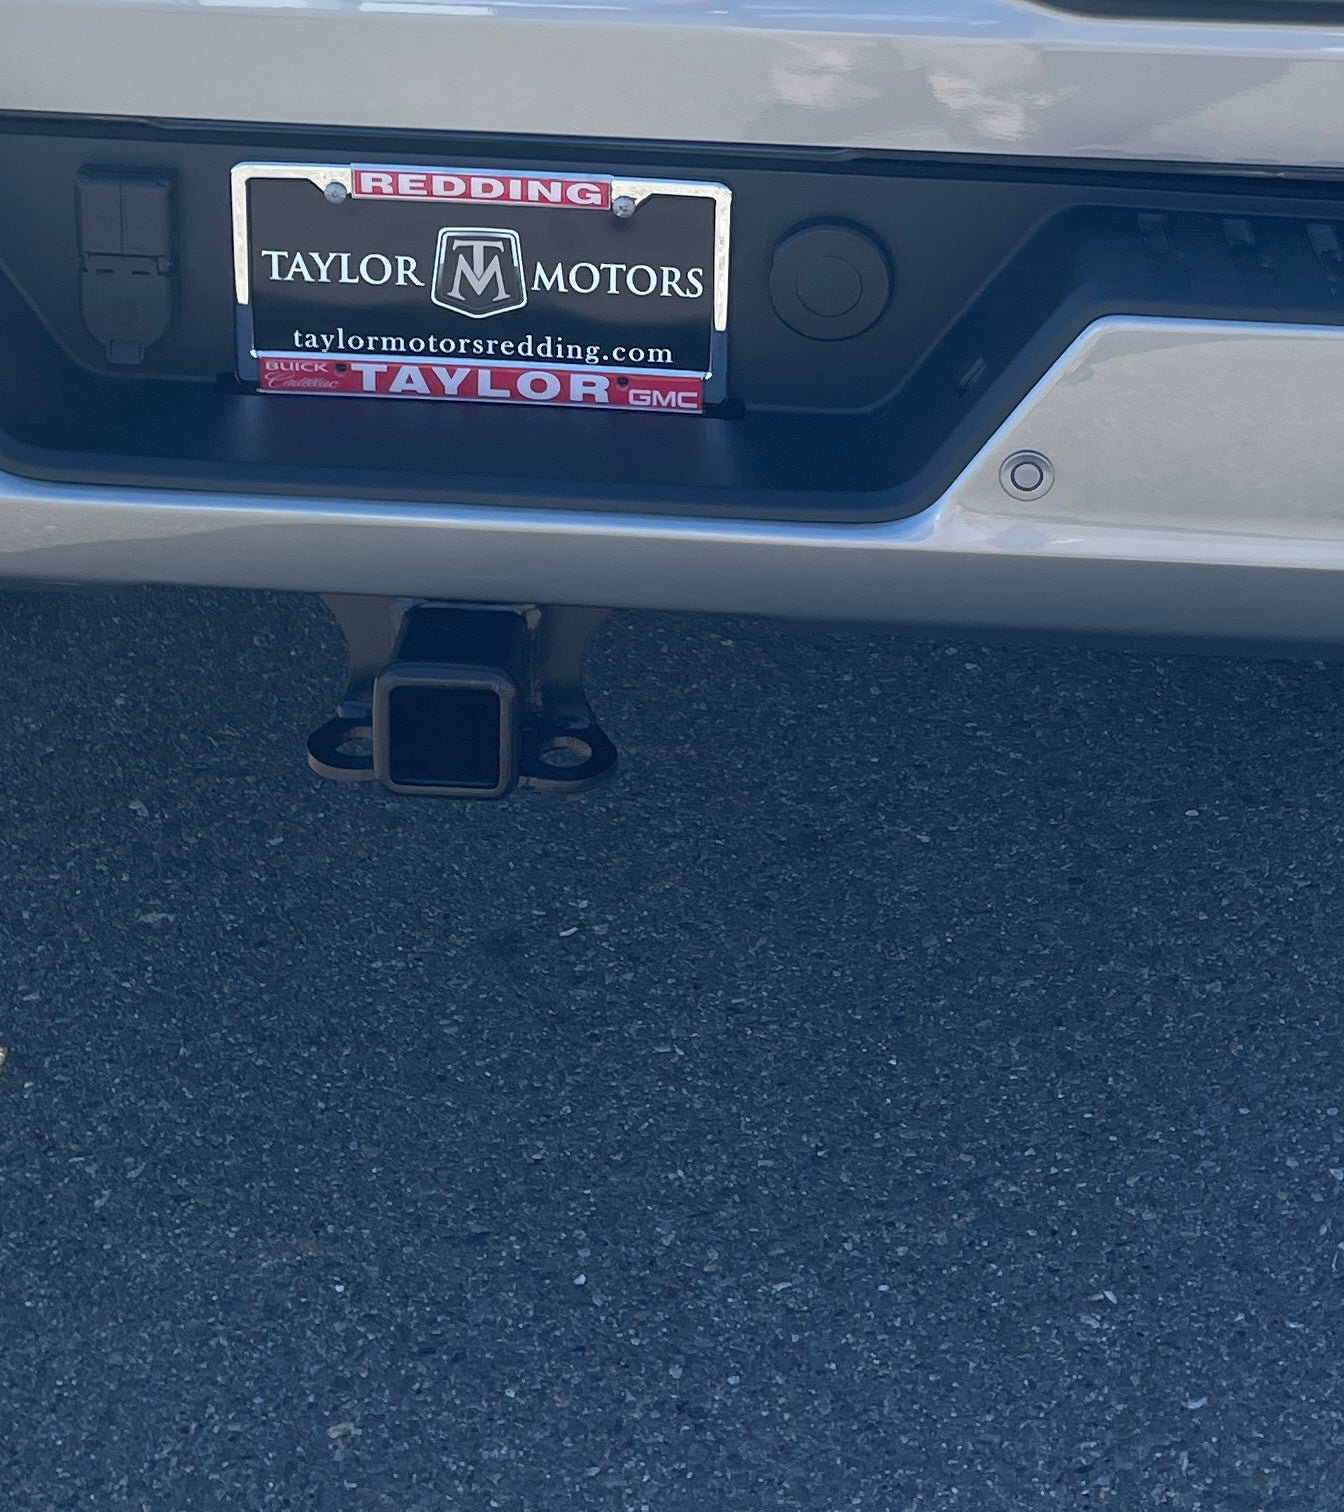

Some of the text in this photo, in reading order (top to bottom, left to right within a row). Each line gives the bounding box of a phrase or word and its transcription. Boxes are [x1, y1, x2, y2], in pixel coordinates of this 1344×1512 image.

[360, 172, 602, 206] REDDING
[261, 249, 425, 287] TAYLOR
[531, 261, 704, 299] MOTORS
[293, 328, 674, 364] taylormotorsredding.com
[265, 361, 329, 373] BUICK
[351, 363, 611, 403] TAYLOR
[628, 388, 699, 410] GMC
